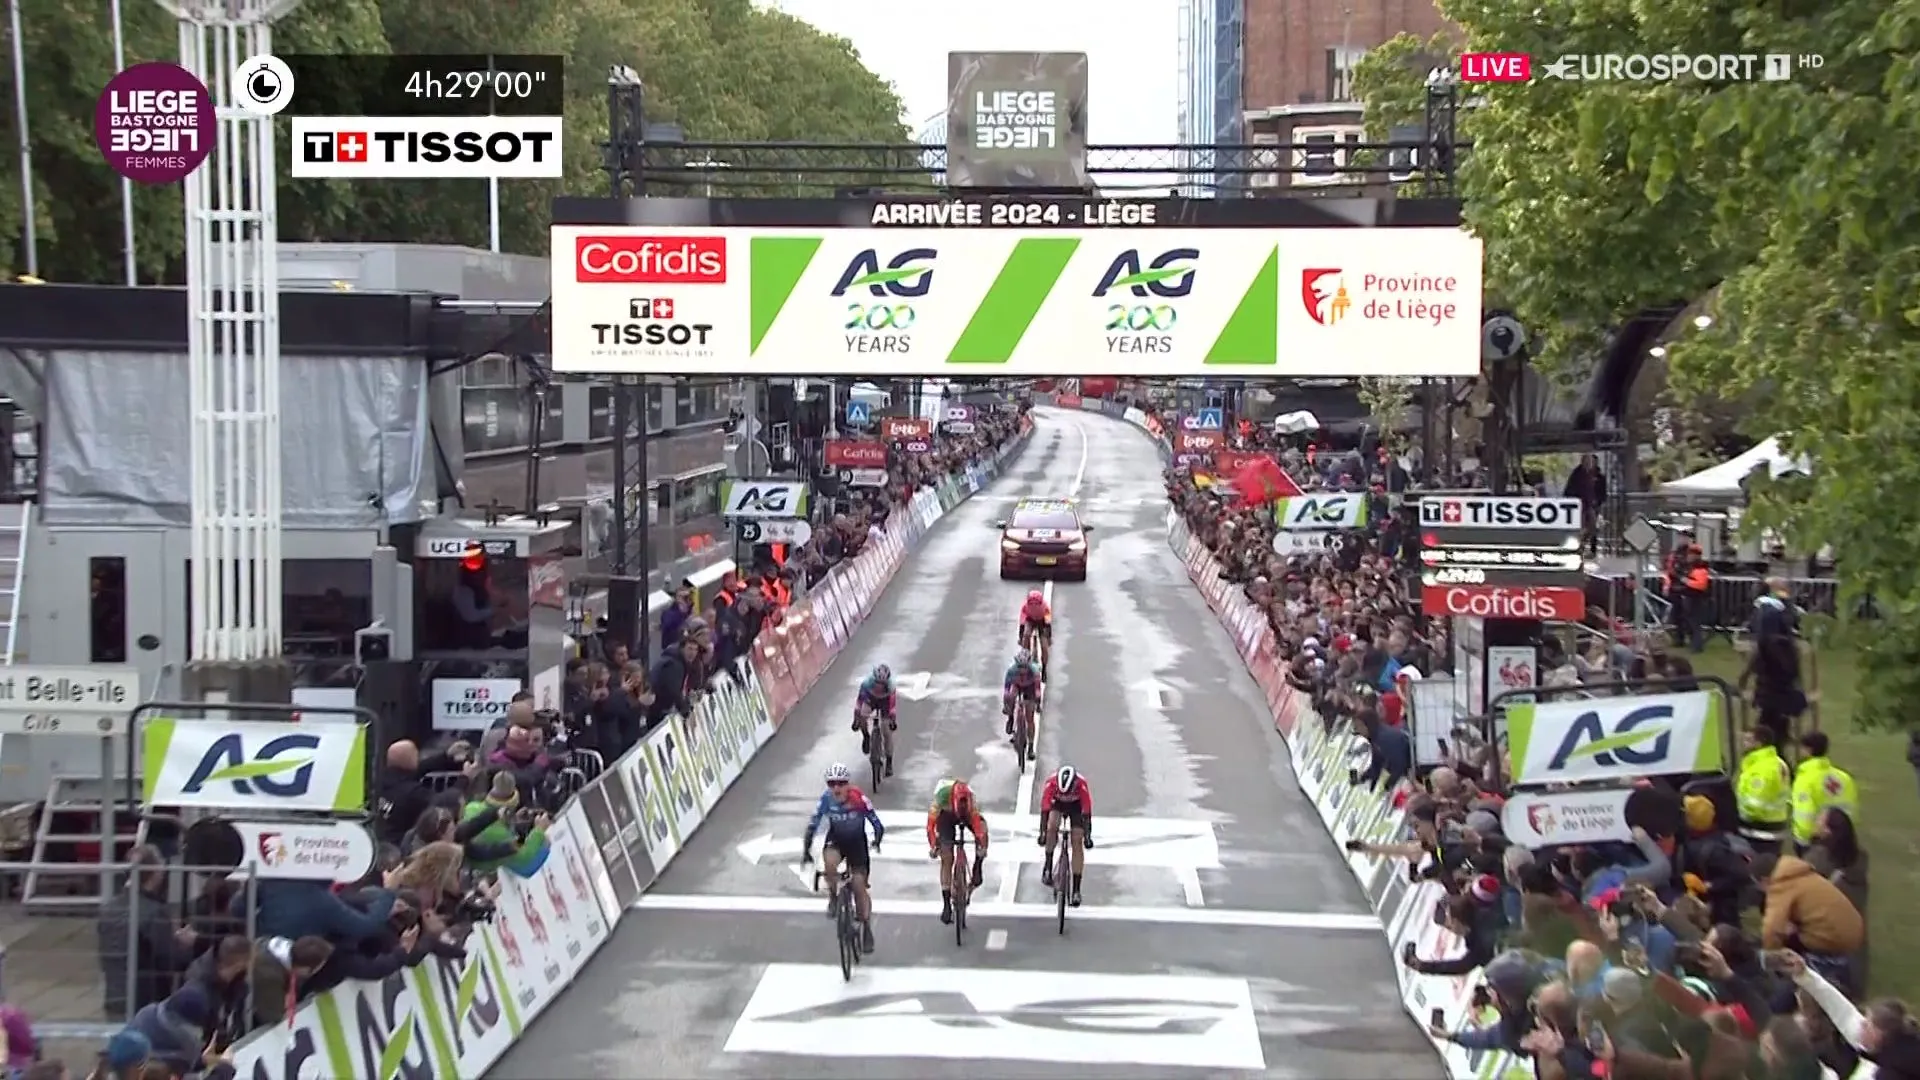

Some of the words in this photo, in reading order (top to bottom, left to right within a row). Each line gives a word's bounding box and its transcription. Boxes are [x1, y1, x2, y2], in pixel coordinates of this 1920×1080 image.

[977, 91, 1055, 113] LIEGE
[976, 114, 1056, 125] BASTOGNE
[872, 200, 982, 224] ARRIVÉE
[991, 204, 1060, 224] 2024
[1084, 200, 1155, 224] LIÈGE
[580, 243, 721, 275] Cofidis
[831, 248, 938, 297] AG
[1092, 249, 1200, 297] AG
[1364, 273, 1457, 292] Province
[845, 303, 915, 330] 200
[1106, 305, 1177, 331] 200
[1364, 299, 1390, 319] de
[1397, 298, 1457, 326] Liège
[591, 324, 713, 345] TISSOT
[845, 336, 911, 353] YEARS
[1106, 337, 1172, 354] YEARS
[736, 487, 789, 511] AG
[1294, 498, 1349, 522] AG
[1466, 502, 1578, 524] TISSOT
[431, 542, 461, 554] UCI
[1447, 588, 1556, 617] Cofidis
[444, 701, 509, 714] TISSOT
[1547, 705, 1674, 770] AG
[180, 733, 321, 797] AG
